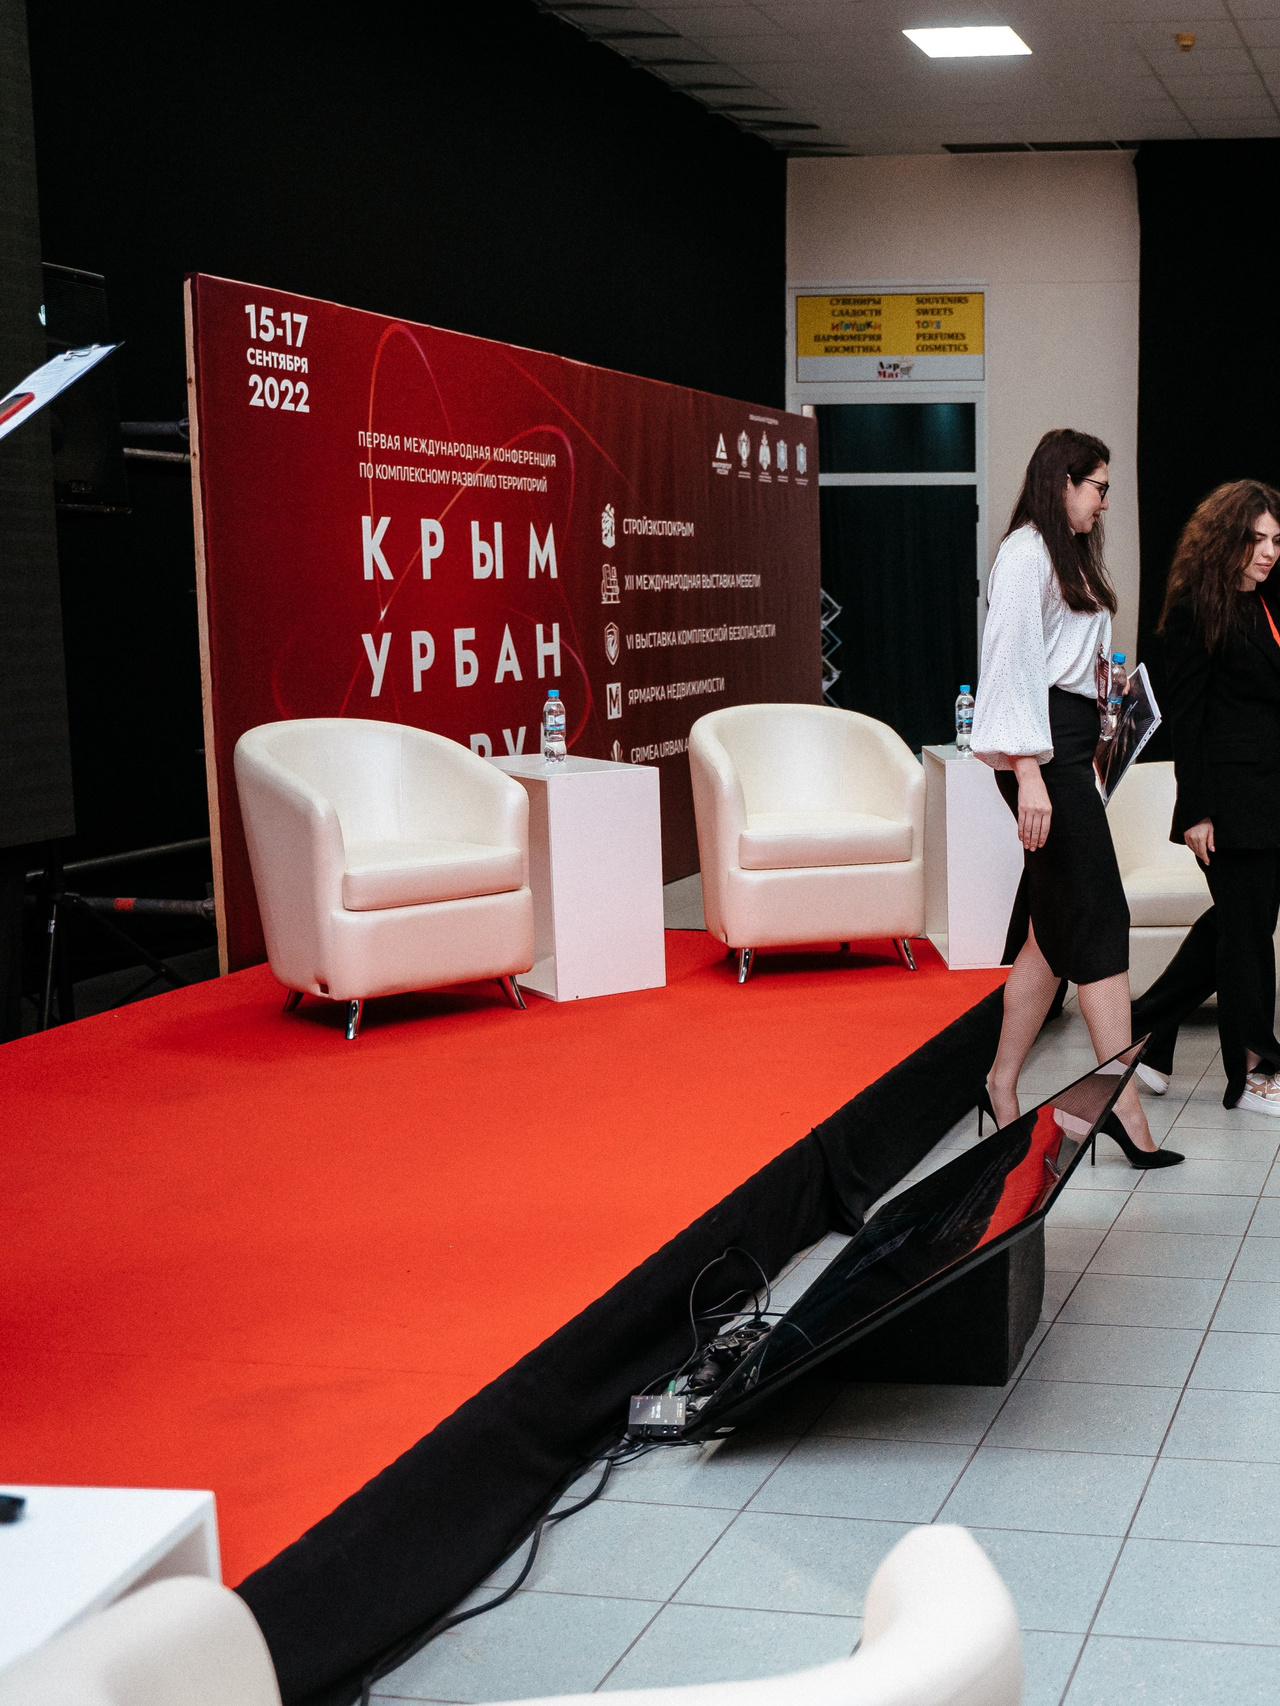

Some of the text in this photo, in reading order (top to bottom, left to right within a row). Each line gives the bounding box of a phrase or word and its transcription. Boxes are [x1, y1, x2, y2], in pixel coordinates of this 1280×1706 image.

[829, 297, 882, 306] СУВЕНИРЫ
[915, 296, 969, 305] SOUVENIRS
[831, 309, 882, 317] СЛАДОСТИ
[915, 308, 954, 316] SWEETS
[244, 303, 309, 348] 15-17
[915, 320, 941, 330] TOYS
[813, 333, 882, 343] ПАРФЮМЕРИЯ
[915, 332, 966, 341] PERFUMES
[824, 345, 882, 353] КОСМЕТИКА
[915, 344, 969, 352] COSMETICS
[246, 347, 309, 374] СЕНТЯБРЯ
[248, 373, 311, 413] 2022
[358, 431, 557, 468] ПЕРВАЯ МЕЖДУНАРОДНАЯ КОНФЕРЕНЦИЯ
[359, 462, 548, 493] ПО КОМПЛЕКСНОМУ РАЗВИТИЮ ТЕРРИТОРИЙ
[622, 515, 695, 537] СТРОЙЭКСПОКРЫМ
[361, 515, 559, 581] КРЫМ
[635, 574, 702, 592] МЕЖДУНАРОДНАЯ
[701, 574, 736, 589] ВЫСТАВКА
[735, 574, 762, 588] МЕБЕЛИ
[635, 631, 677, 650] ВЫСТАВКА
[677, 624, 729, 646] КОМПЛЕКСНОЙ
[728, 624, 776, 641] БЕЗОПАСНОСТИ
[361, 622, 562, 698] УРБАН
[628, 677, 725, 705] ЯРМАРКА НЕДВИЖИМОСТИ
[630, 742, 660, 764] CRIMEA
[659, 739, 684, 760] URBAN
